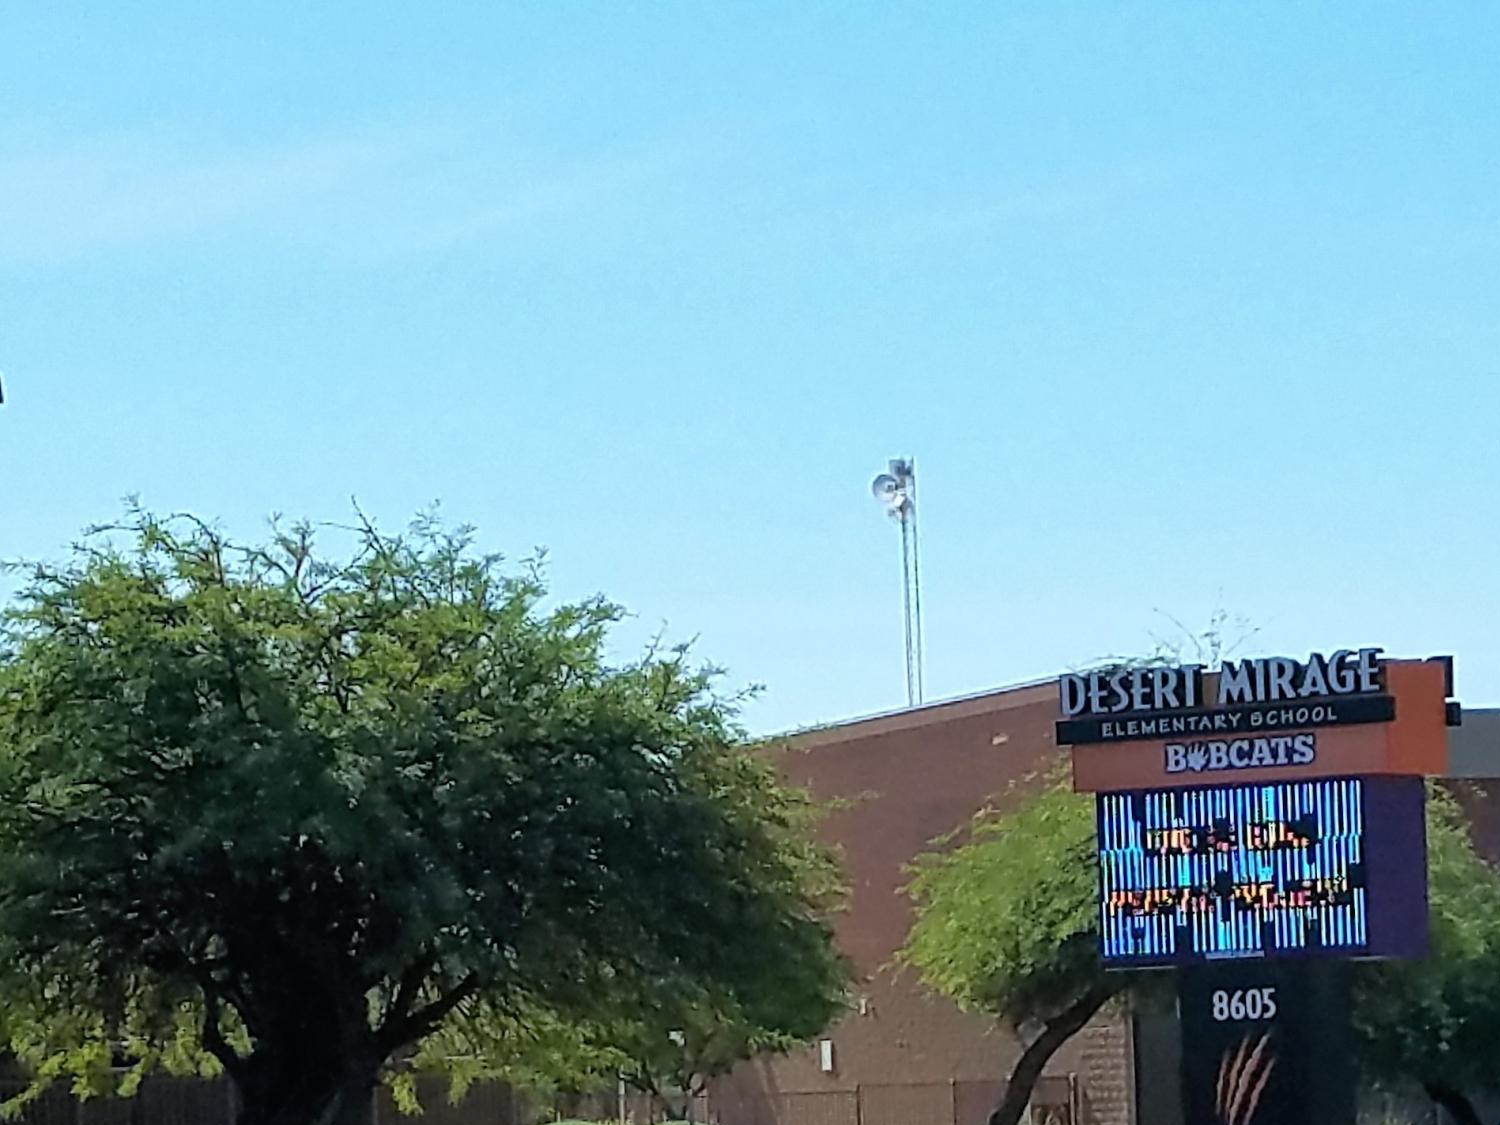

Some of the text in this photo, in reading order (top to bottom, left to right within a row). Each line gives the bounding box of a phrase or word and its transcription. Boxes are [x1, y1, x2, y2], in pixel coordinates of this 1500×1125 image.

[1060, 649, 1381, 716] DESERT MIRAGE
[1102, 706, 1338, 738] ELEMENTARY SCHOOL
[1212, 987, 1277, 1021] 8605
